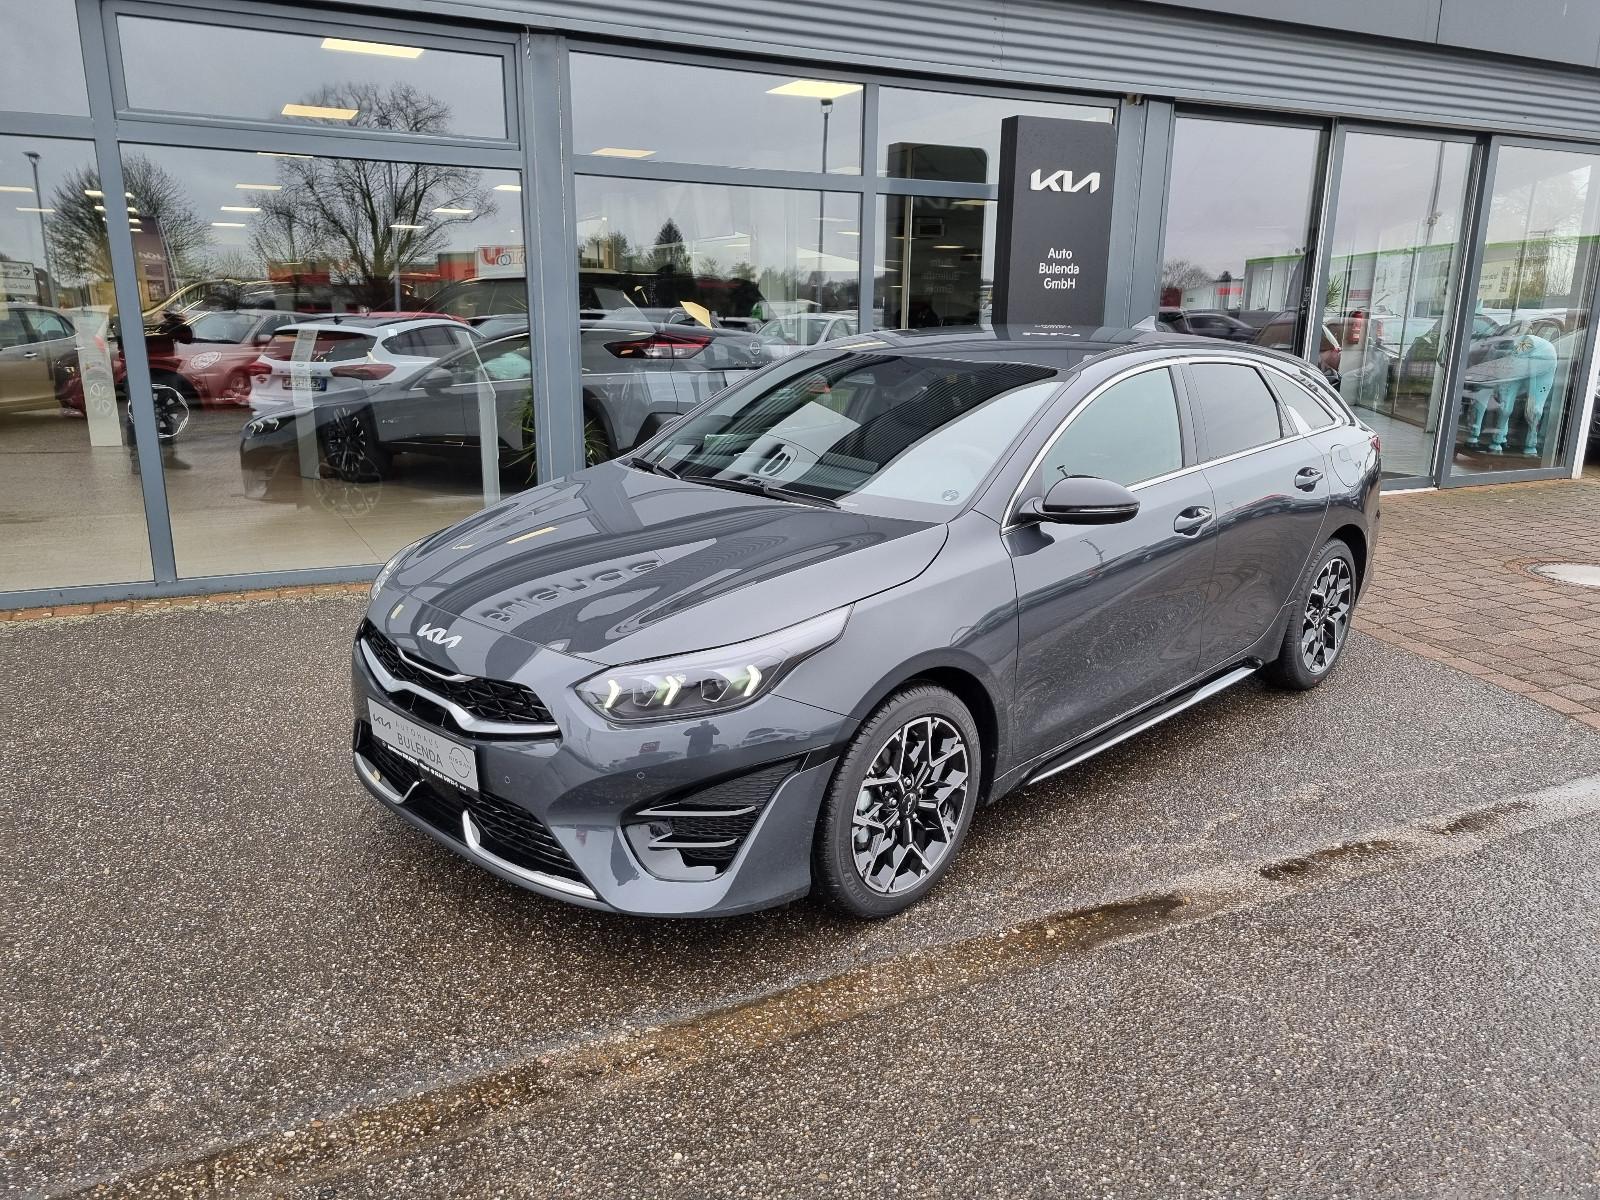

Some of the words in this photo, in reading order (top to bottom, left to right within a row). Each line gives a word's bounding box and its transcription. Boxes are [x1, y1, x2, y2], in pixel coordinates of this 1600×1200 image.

[1047, 247, 1073, 260] Auto
[1038, 262, 1080, 275] Bulenda
[1043, 278, 1076, 290] GmbH
[397, 732, 444, 768] BULENDA
